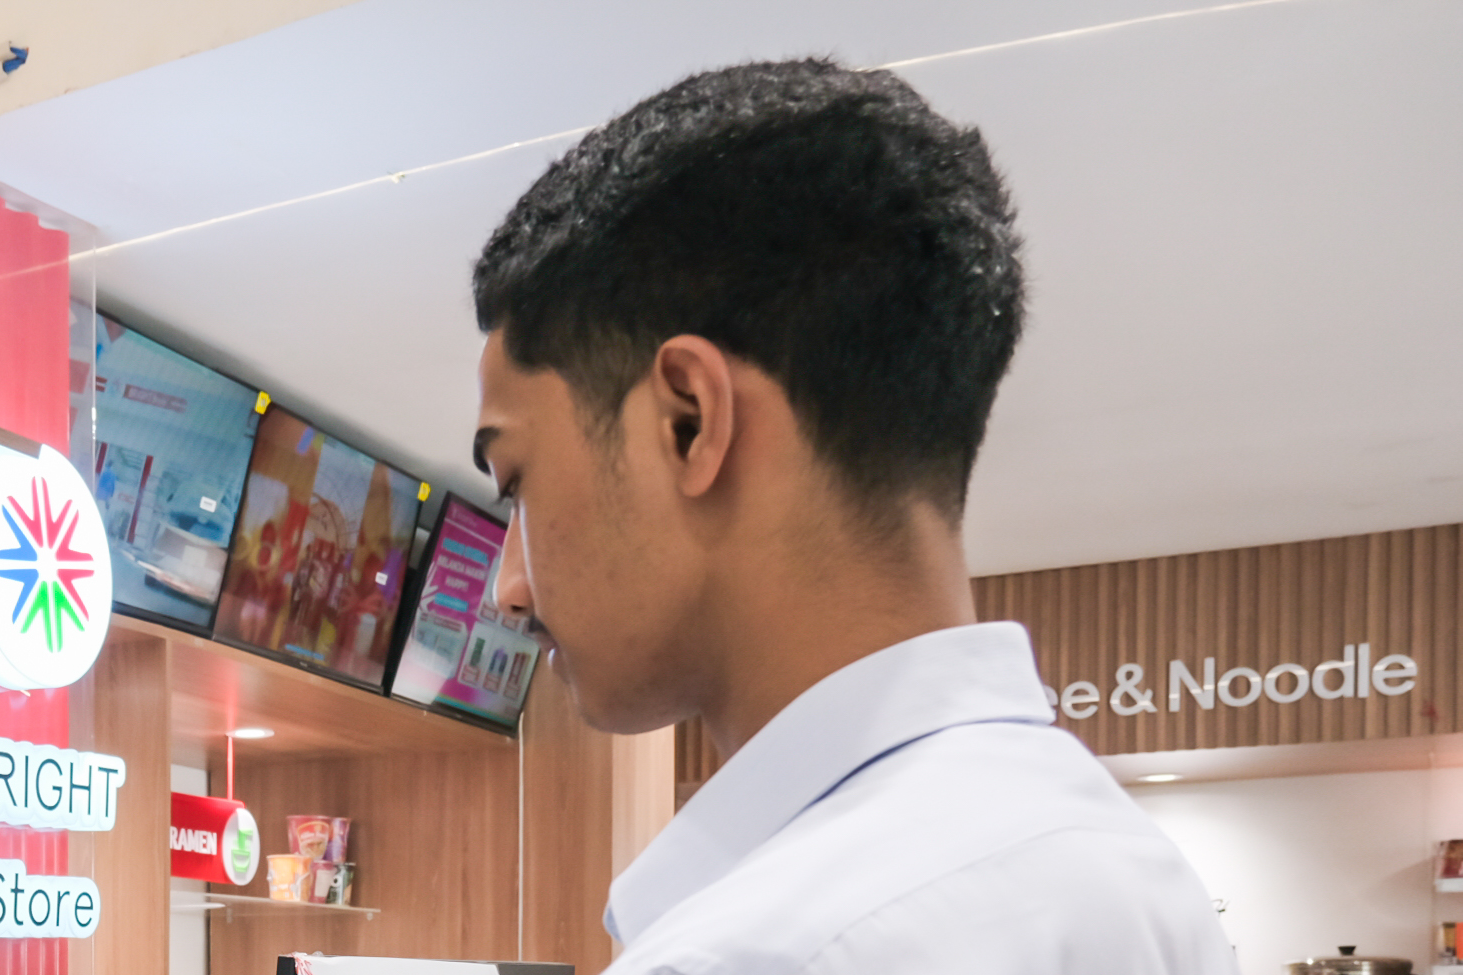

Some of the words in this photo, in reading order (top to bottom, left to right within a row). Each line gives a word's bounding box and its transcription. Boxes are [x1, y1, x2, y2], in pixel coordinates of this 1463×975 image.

[1110, 663, 1157, 716] &
[1168, 642, 1417, 712] Noodle
[170, 826, 217, 856] RAMEN
